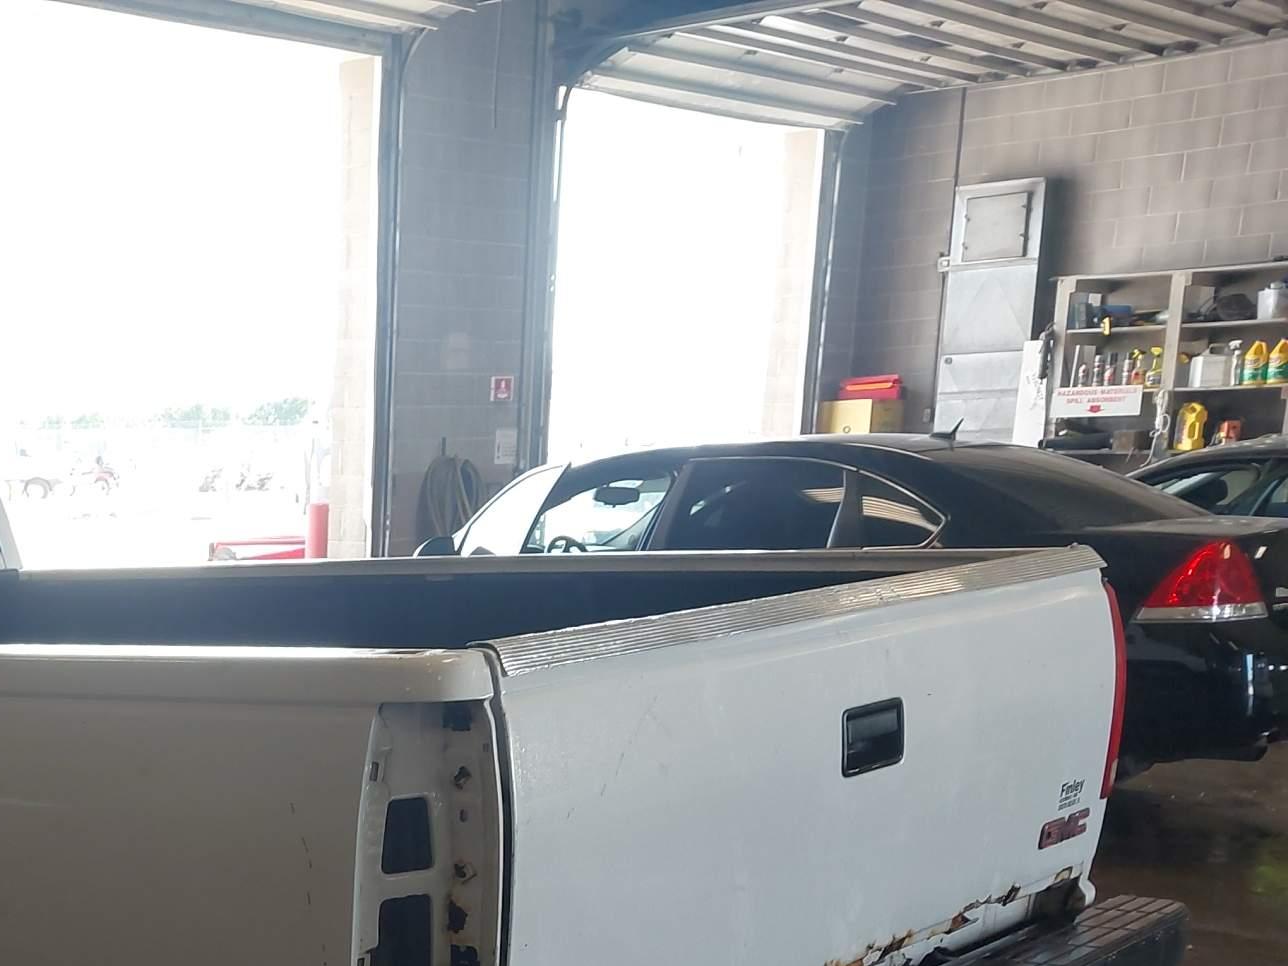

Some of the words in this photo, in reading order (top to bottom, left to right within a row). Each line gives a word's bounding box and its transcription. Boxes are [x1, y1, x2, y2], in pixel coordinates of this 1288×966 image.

[1057, 389, 1098, 397] HAZARDOUS
[1100, 387, 1138, 396] MATERIALS
[1065, 396, 1083, 404] SPILL
[1087, 395, 1127, 404] ABSORBENT
[1038, 808, 1090, 849] GMC
